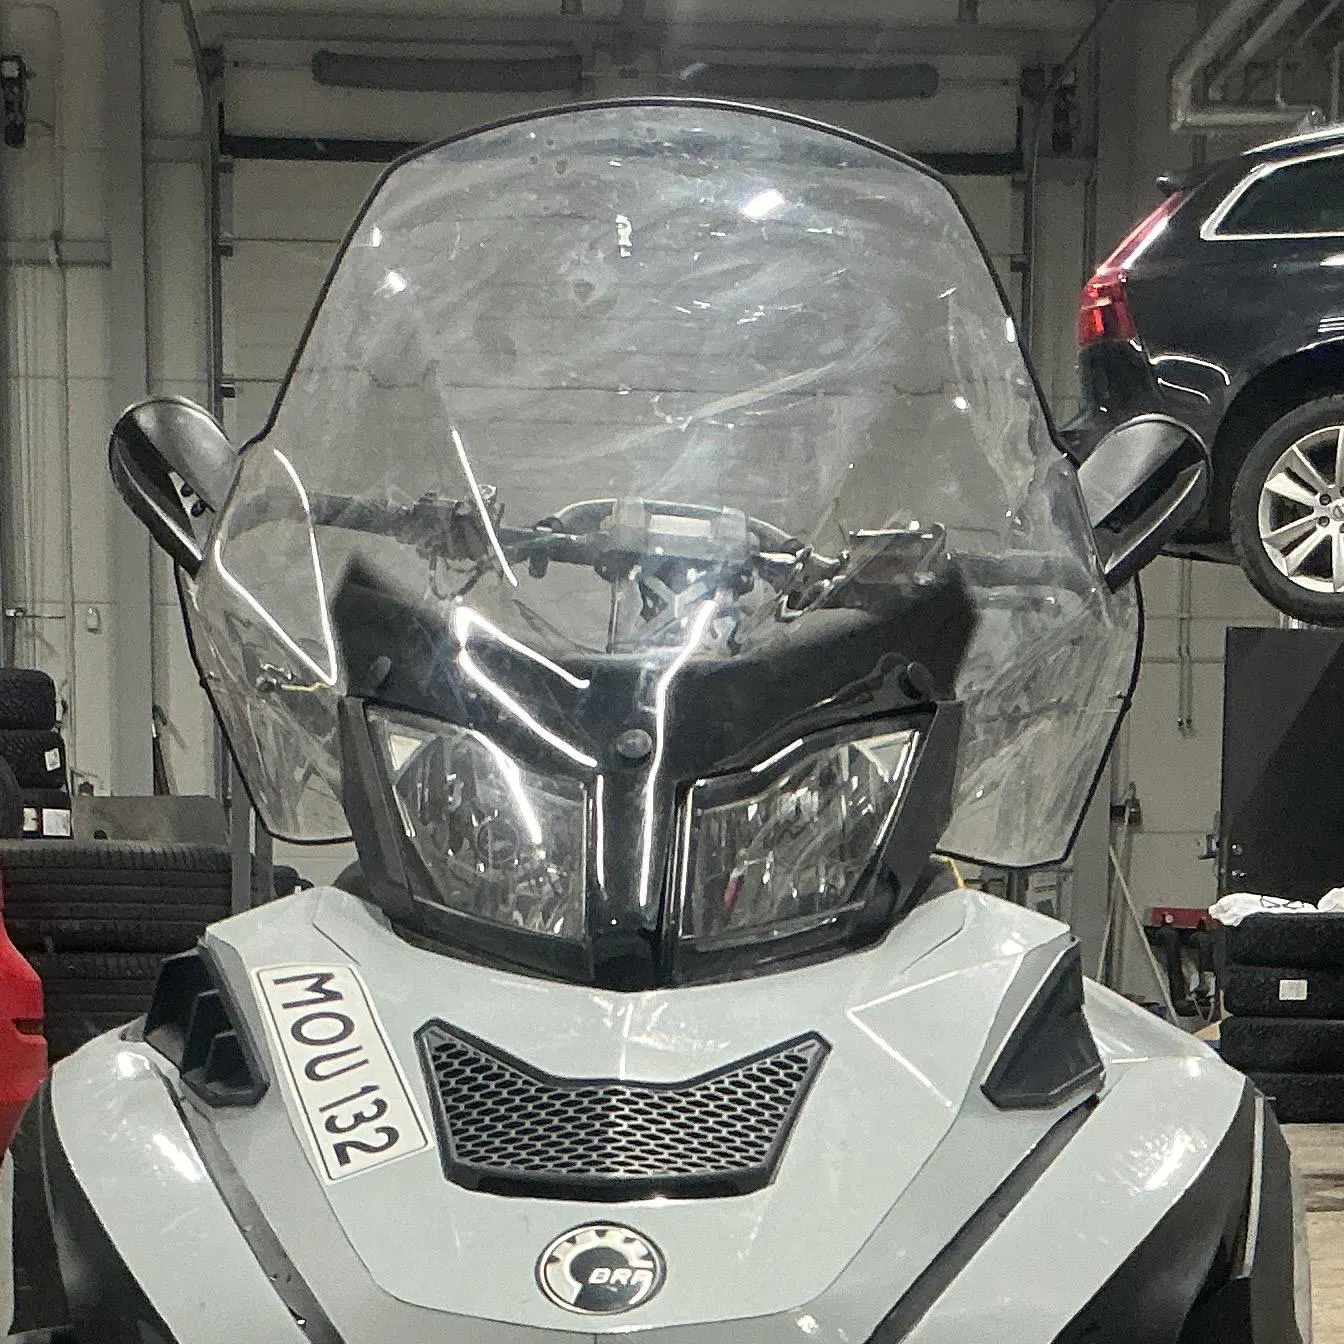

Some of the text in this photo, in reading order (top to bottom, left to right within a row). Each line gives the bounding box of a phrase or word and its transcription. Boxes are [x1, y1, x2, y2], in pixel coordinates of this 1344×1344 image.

[272, 971, 400, 1168] MOU 132
[587, 1267, 654, 1305] BRP
